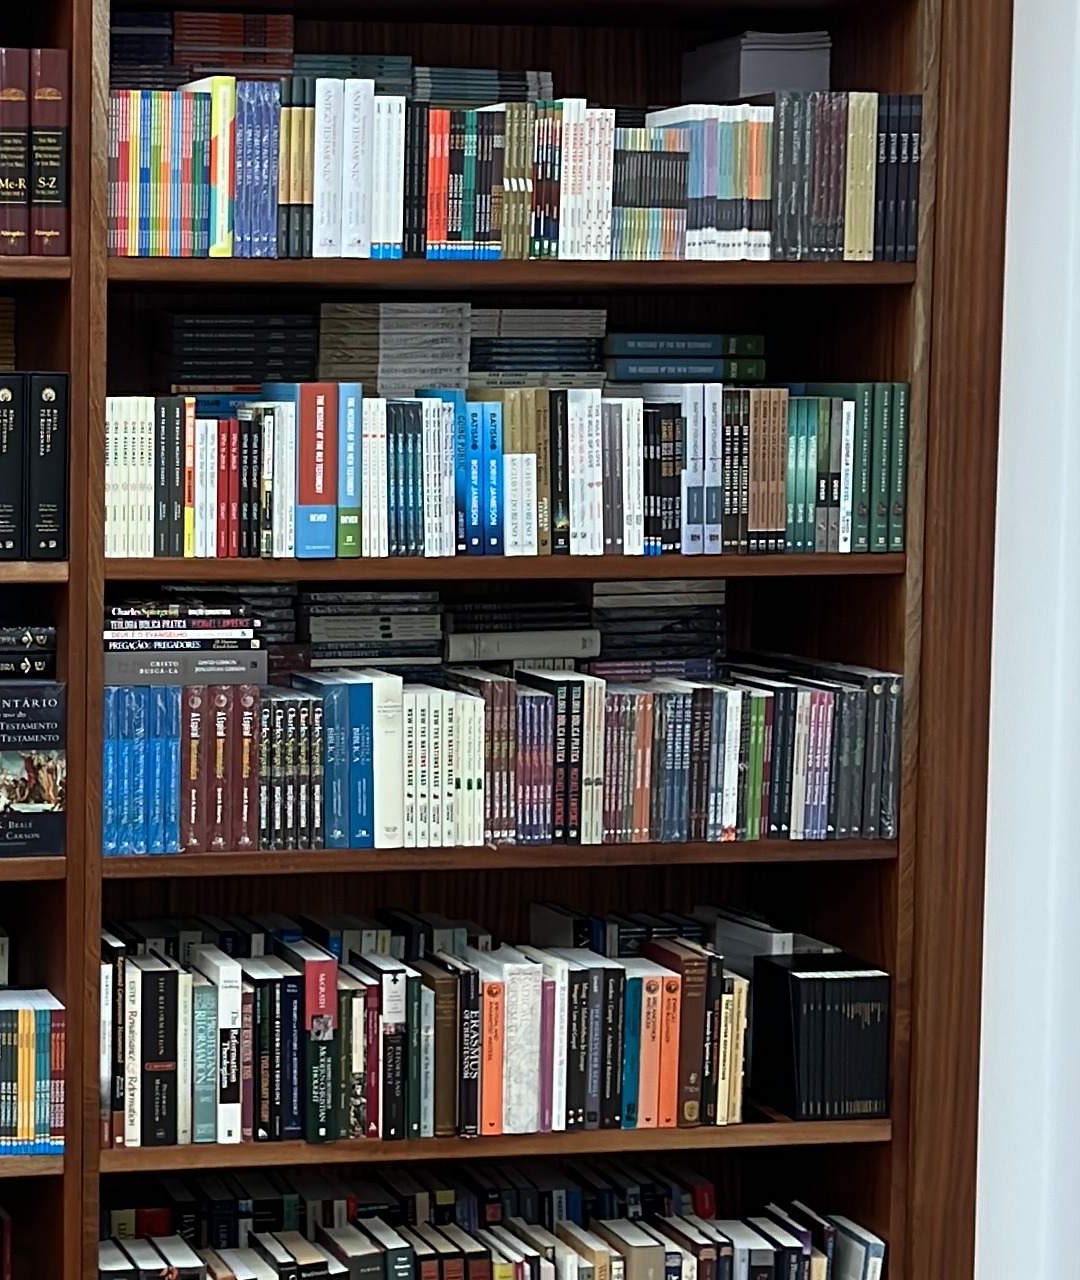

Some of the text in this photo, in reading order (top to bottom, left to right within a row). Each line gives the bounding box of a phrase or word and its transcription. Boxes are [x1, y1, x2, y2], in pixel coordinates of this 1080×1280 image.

[38, 177, 56, 188] S-Z
[310, 514, 327, 522] DEVER
[112, 608, 141, 616] Charles
[111, 620, 187, 629] TEOLOGIA BÍBLICA PRÁTICA
[109, 640, 148, 651] PREGAÇÃO
[0, 722, 58, 730] TESTAMENTO
[0, 734, 59, 742] TESTAMENTO
[8, 821, 33, 829] BEALE
[6, 832, 40, 840] CARSON
[463, 1010, 469, 1019] OF
[128, 1011, 137, 1061] Renaissance
[195, 1010, 206, 1084] REFORMATION
[206, 1016, 216, 1083] PROTESTANT
[230, 1011, 239, 1082] The Reformation
[470, 1010, 478, 1080] ERASMUS
[220, 1041, 230, 1088] Theologians
[128, 1076, 137, 1126] Reformation
